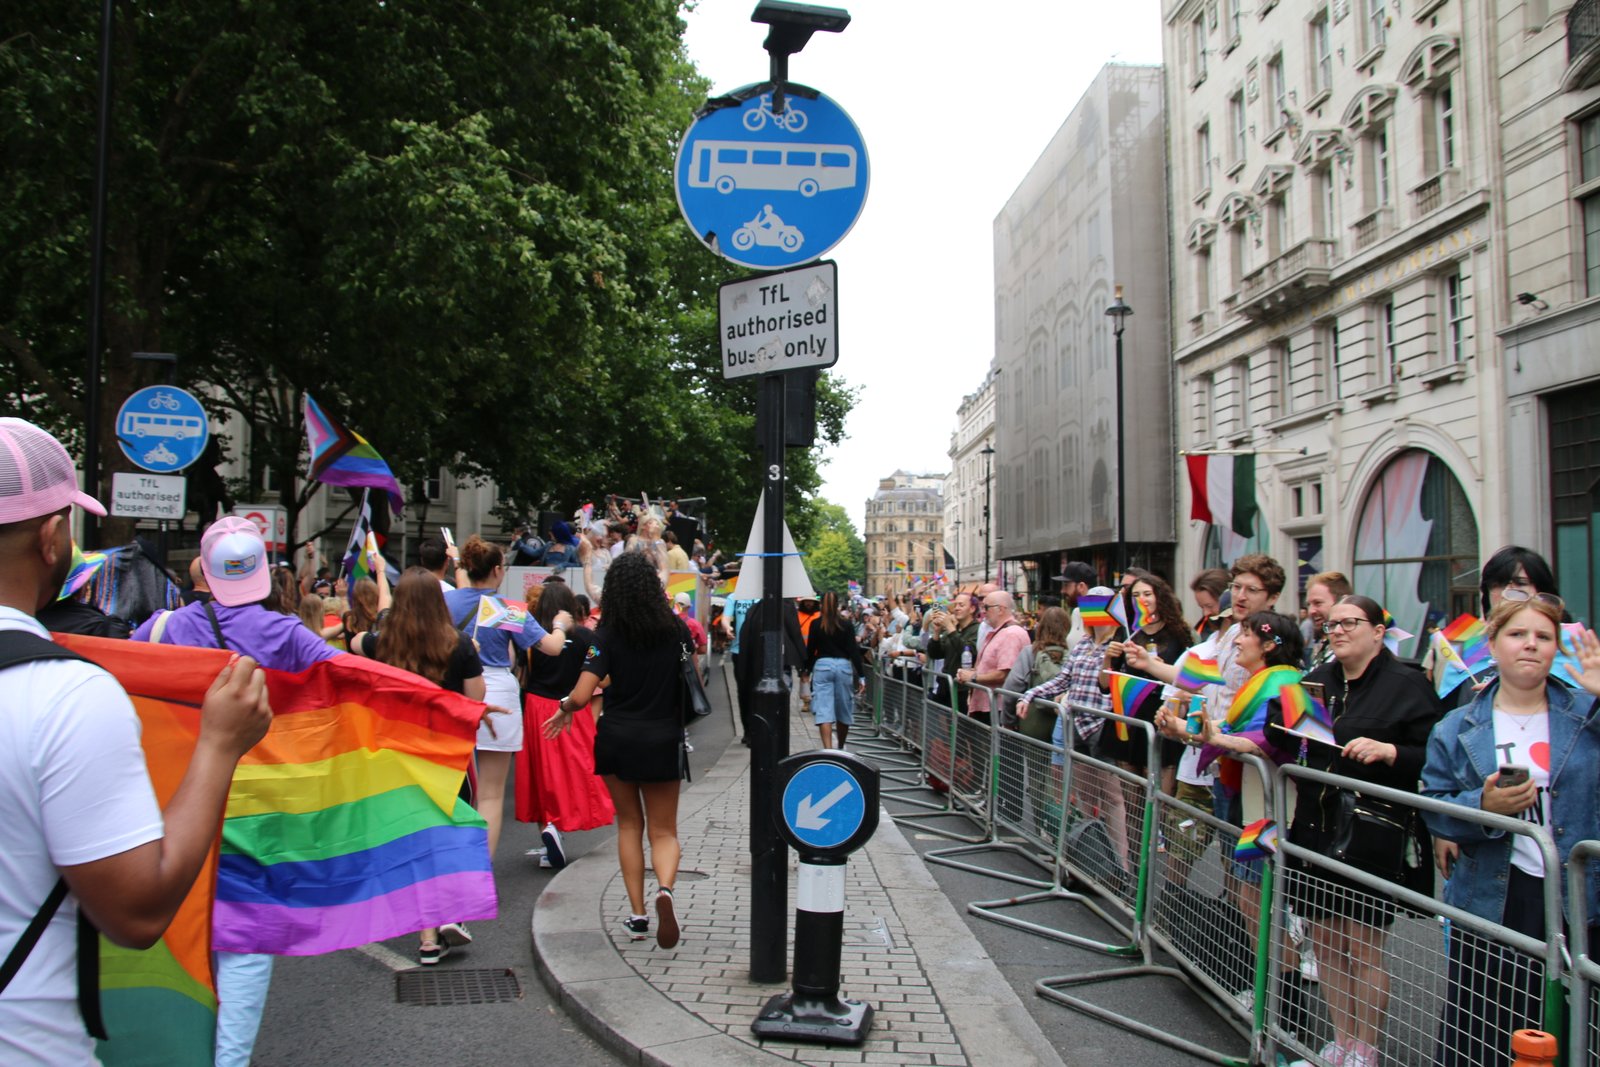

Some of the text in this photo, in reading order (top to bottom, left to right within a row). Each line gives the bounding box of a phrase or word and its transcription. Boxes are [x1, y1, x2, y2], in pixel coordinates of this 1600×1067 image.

[759, 283, 789, 306] TfL
[727, 304, 827, 340] authorised
[785, 334, 827, 358] only
[768, 464, 780, 481] 3
[139, 478, 160, 489] TfL
[117, 490, 180, 502] authorised
